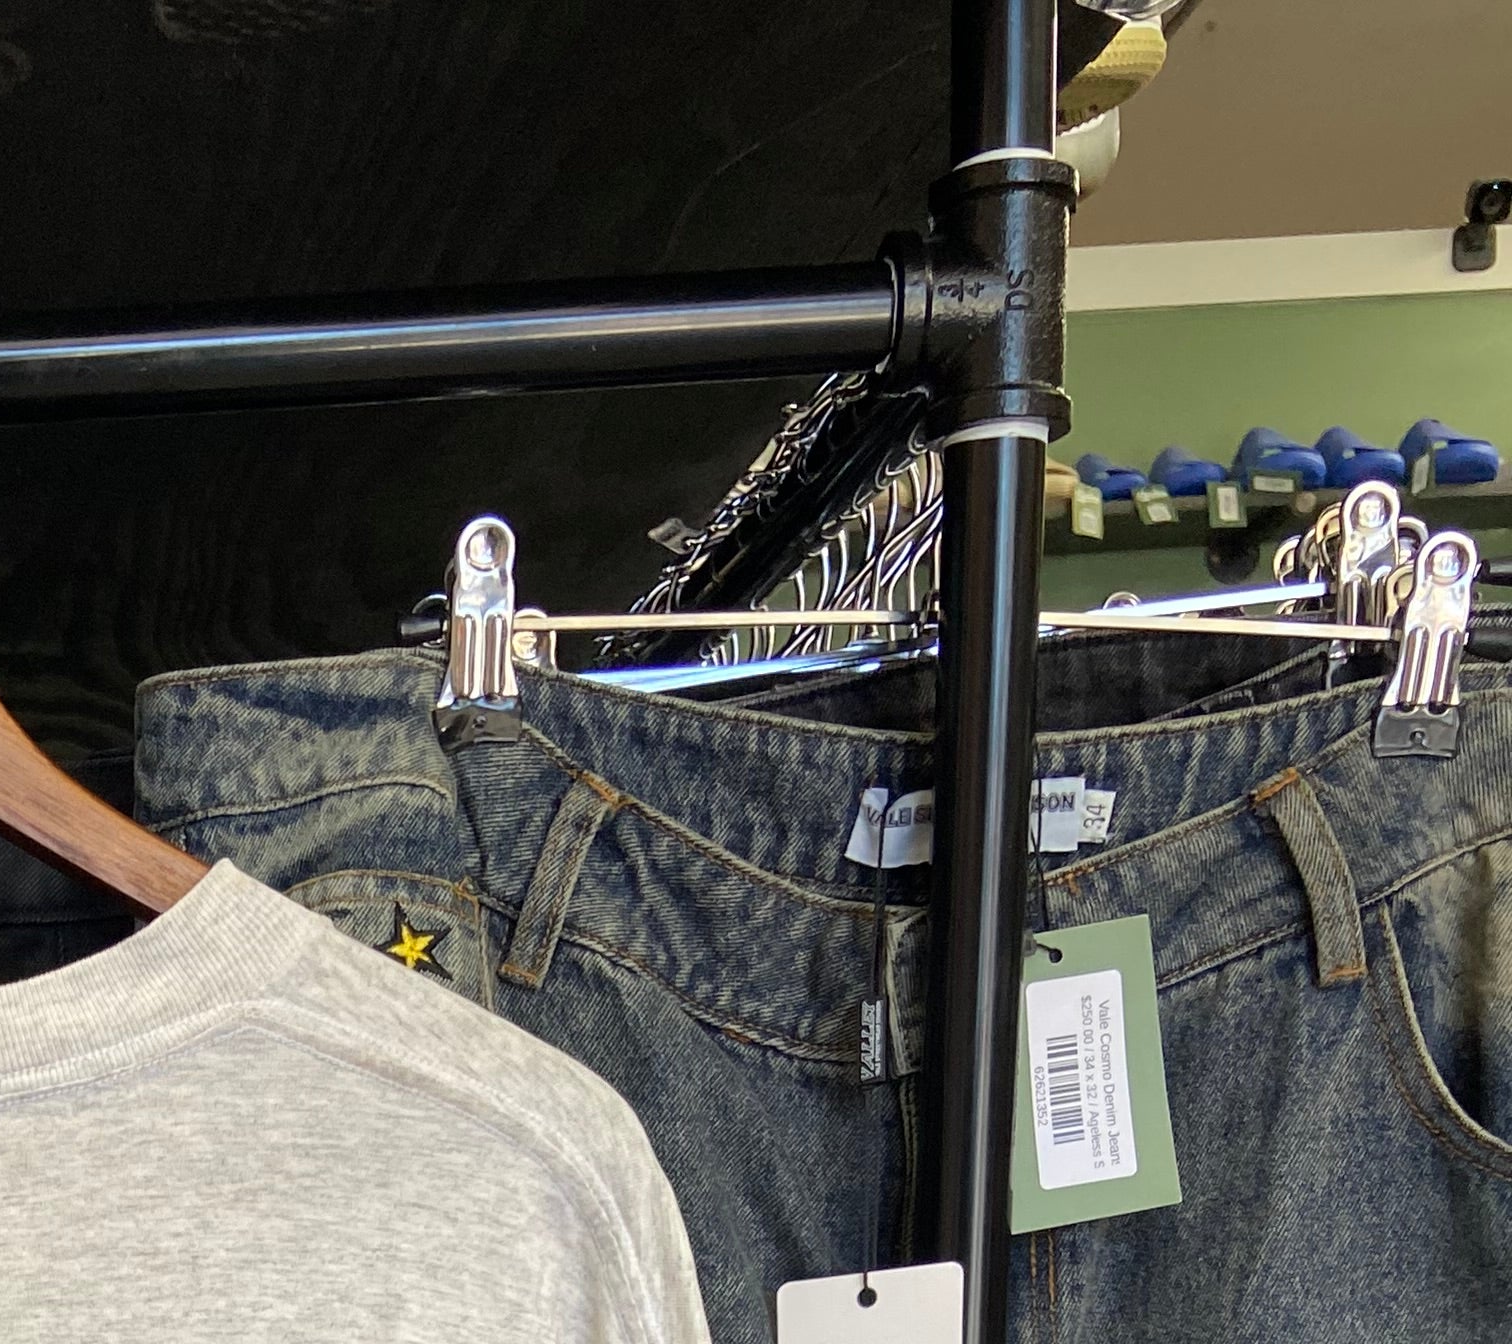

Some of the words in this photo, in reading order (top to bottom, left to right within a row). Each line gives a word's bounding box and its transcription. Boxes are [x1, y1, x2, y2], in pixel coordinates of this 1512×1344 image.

[1083, 803, 1106, 832] 34
[1081, 994, 1095, 1045] $25000
[1097, 1000, 1110, 1031] Vale
[1084, 1056, 1096, 1072] 34
[1099, 1033, 1112, 1081] Cosmo
[1086, 1085, 1098, 1101] 32
[1102, 1083, 1117, 1127] Denim
[1087, 1109, 1102, 1157] Ageless
